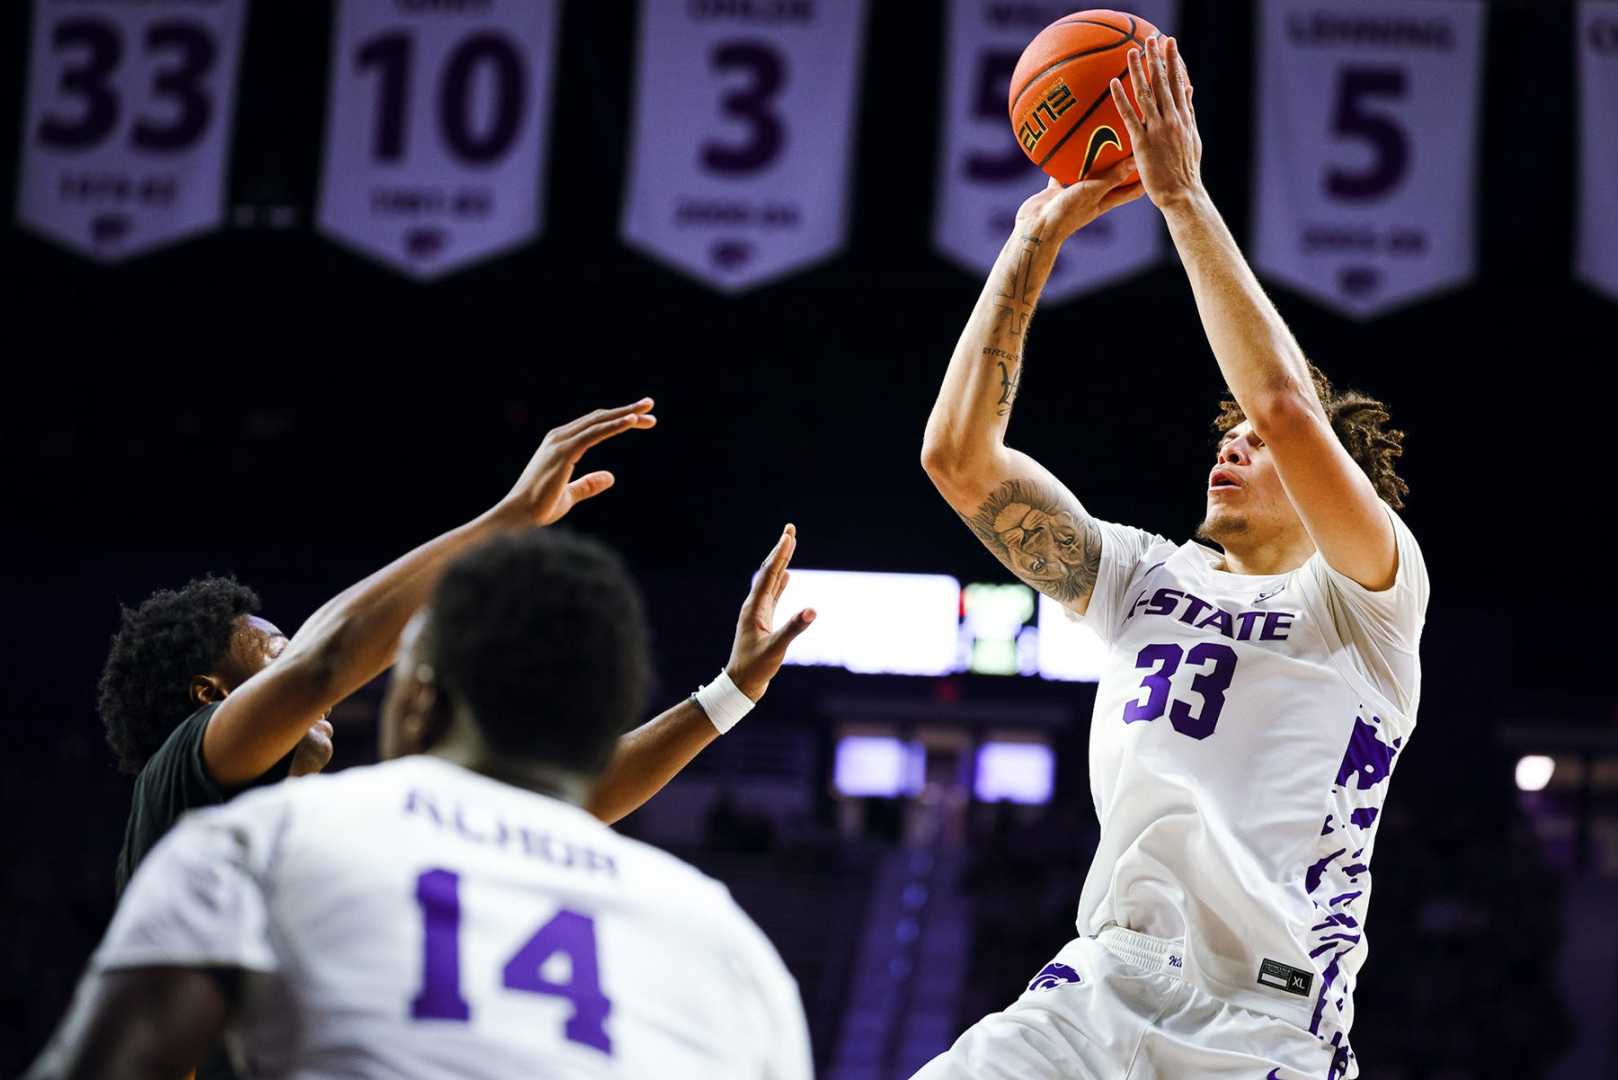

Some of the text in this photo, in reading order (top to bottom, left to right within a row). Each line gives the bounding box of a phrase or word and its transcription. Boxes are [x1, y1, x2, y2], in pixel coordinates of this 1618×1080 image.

[37, 17, 217, 154] 33
[354, 29, 528, 168] 10
[700, 37, 788, 178] 3
[1018, 81, 1077, 154] ELITE
[1322, 65, 1413, 205] 5
[1122, 642, 1238, 741] 33
[410, 867, 613, 1055] 14
[1291, 975, 1306, 990] XL
